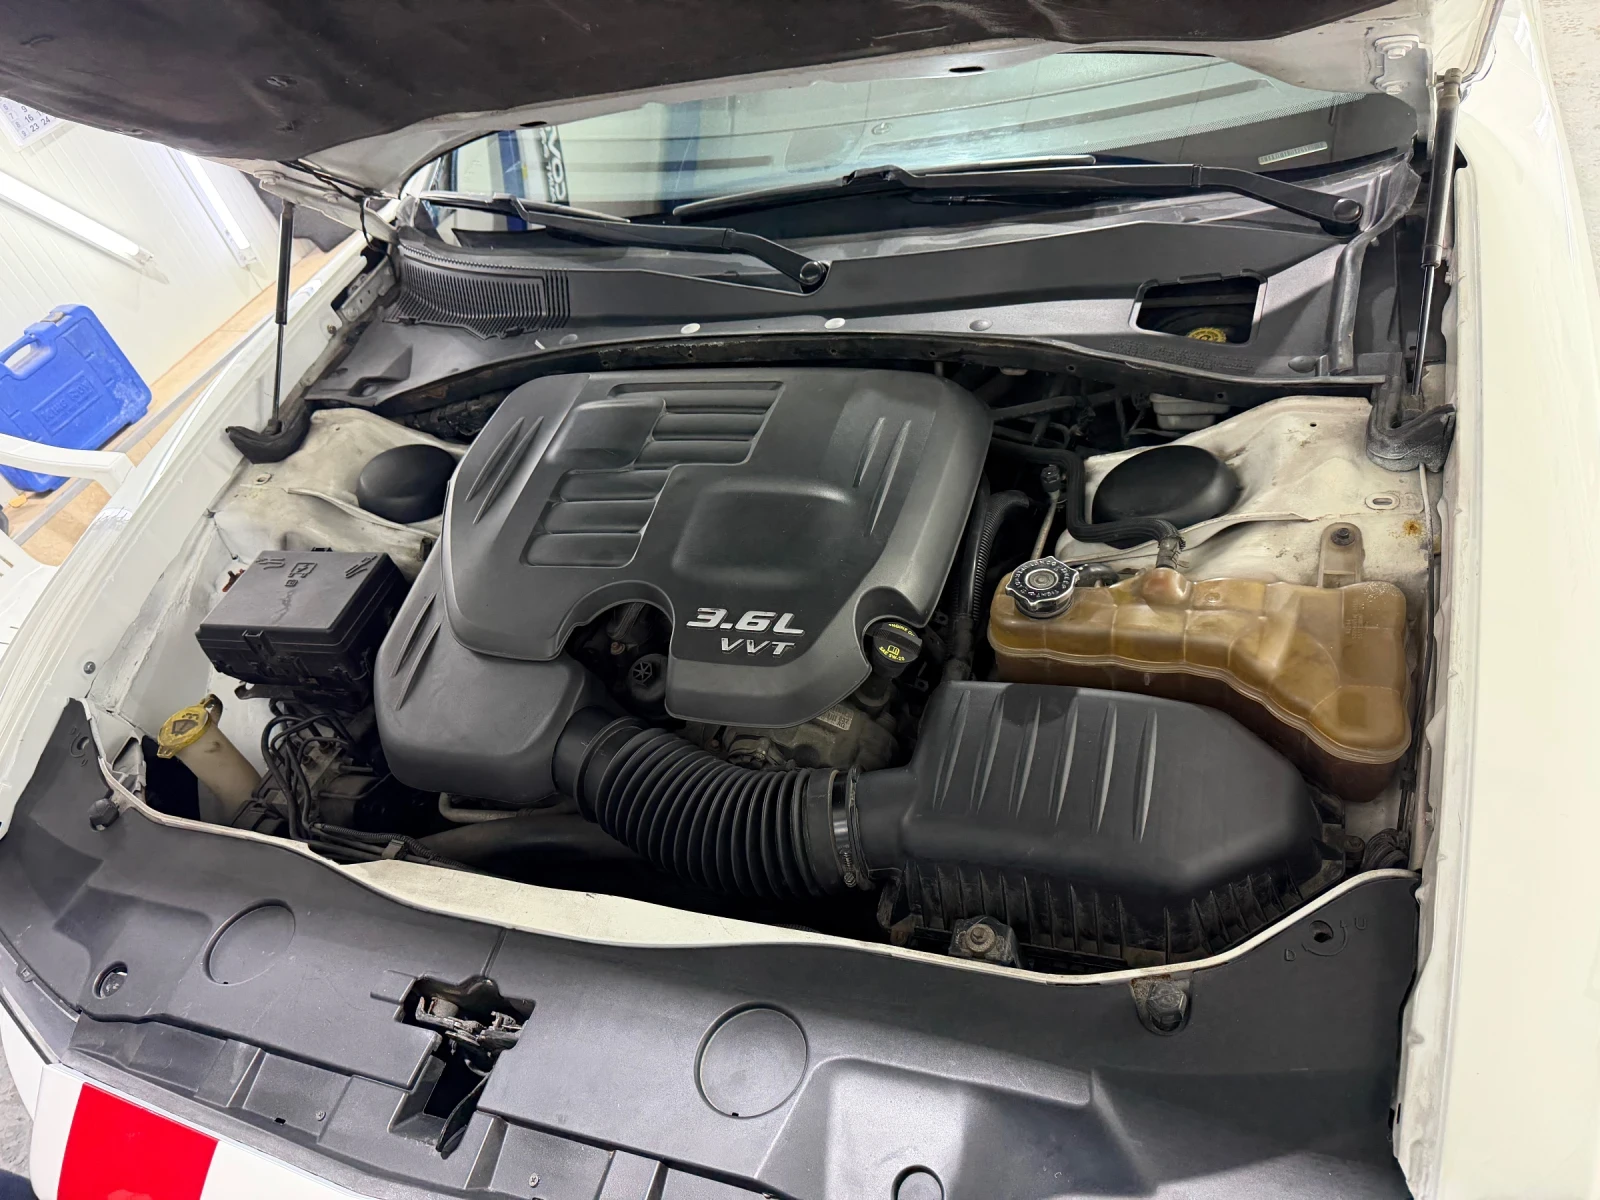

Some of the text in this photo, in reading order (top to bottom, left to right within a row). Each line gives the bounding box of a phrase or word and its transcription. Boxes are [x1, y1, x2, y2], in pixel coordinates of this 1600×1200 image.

[21, 105, 27, 113] 9
[25, 114, 34, 123] 16
[30, 122, 40, 132] 23
[41, 116, 51, 126] 24
[686, 607, 805, 635] 3.6L
[720, 637, 796, 657] VVT
[1283, 948, 1297, 962] D
